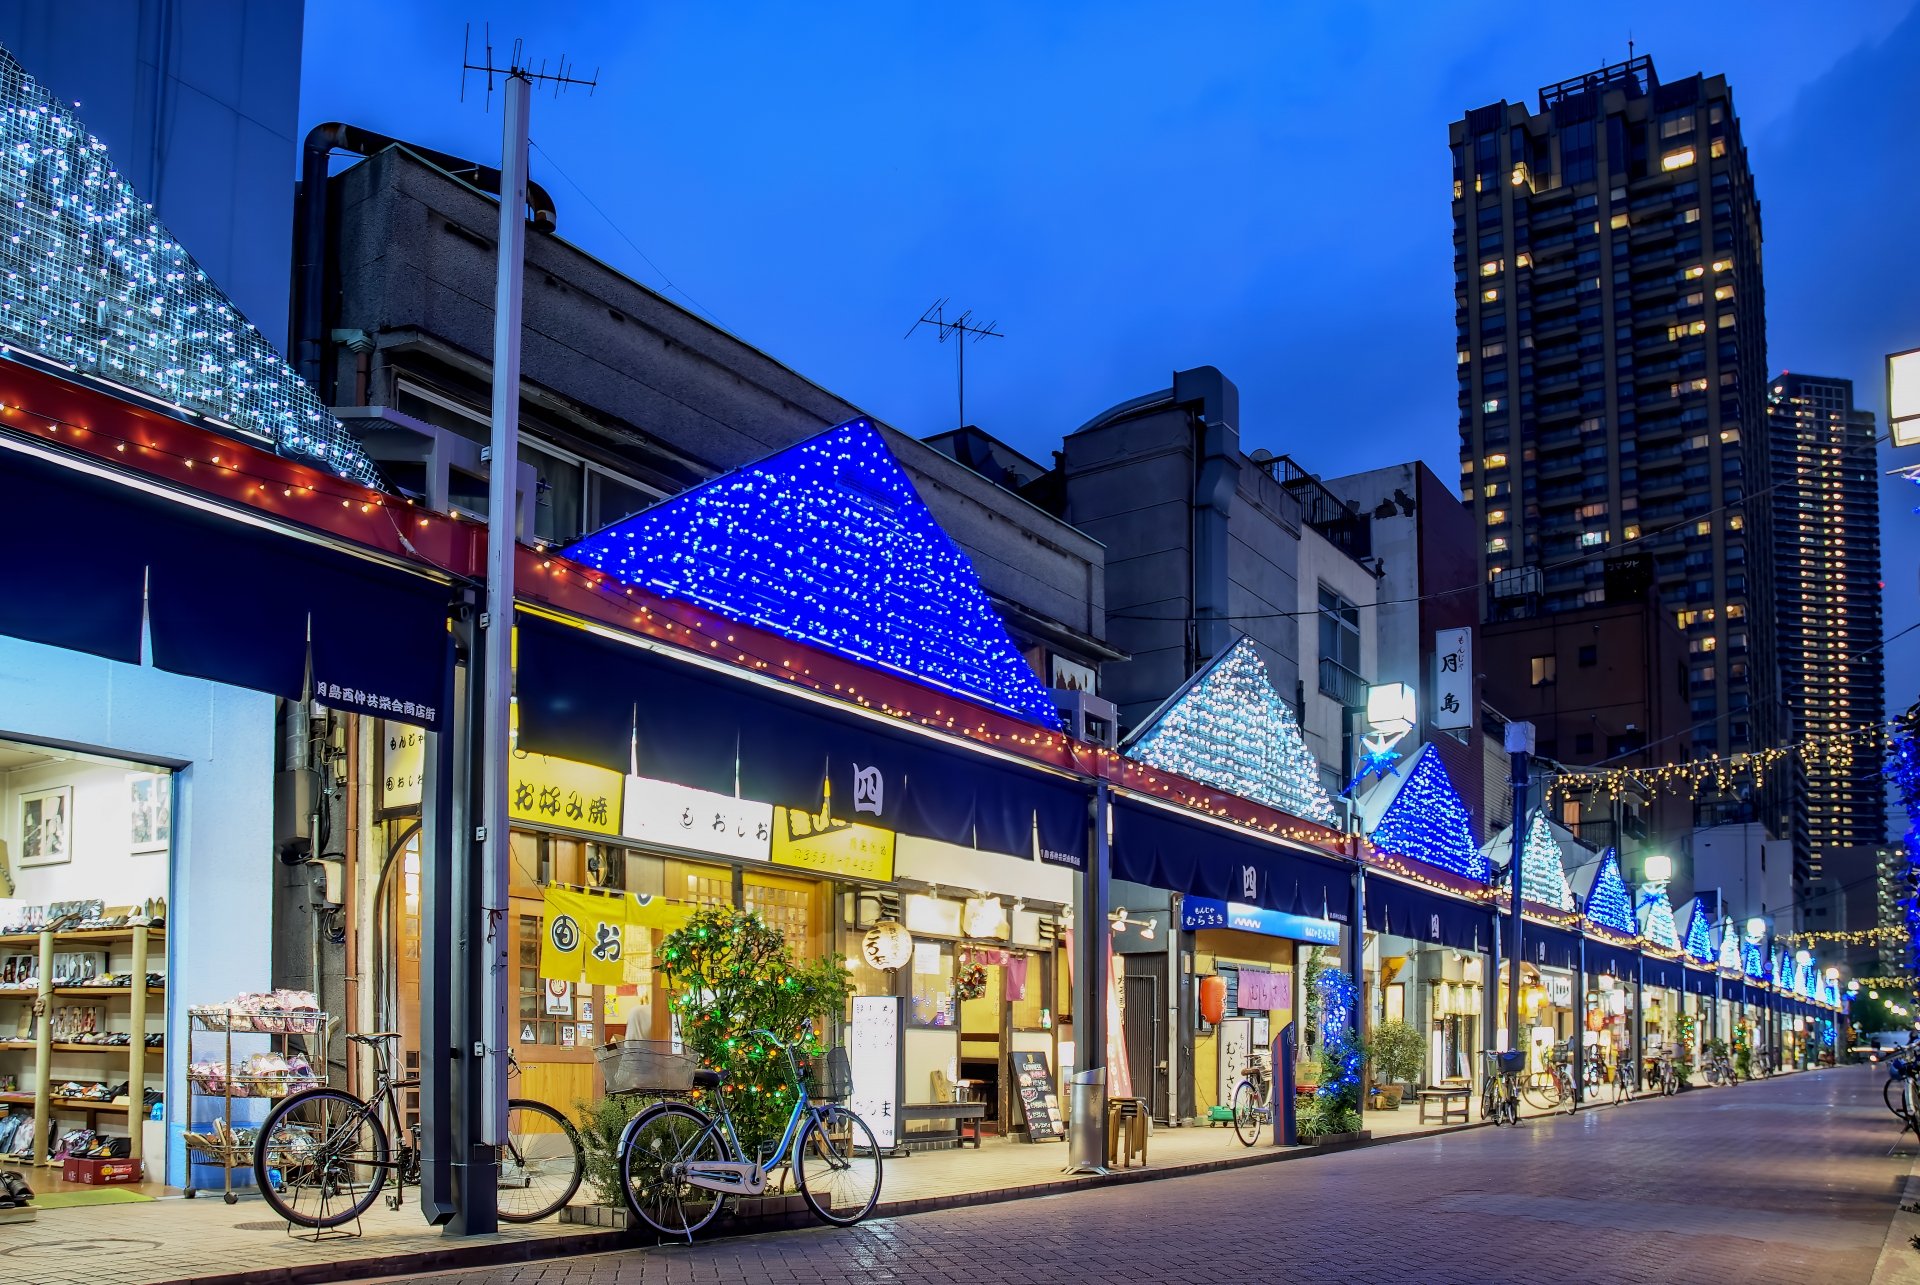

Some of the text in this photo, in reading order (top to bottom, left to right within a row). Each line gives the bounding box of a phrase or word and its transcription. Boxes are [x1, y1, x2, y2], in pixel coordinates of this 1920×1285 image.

[1457, 635, 1465, 670] もんじゃ
[317, 681, 436, 721] 月島西仲共栄会商店街
[1440, 653, 1460, 714] 月島
[514, 780, 608, 826] お好み焼
[853, 763, 884, 817] 四
[1243, 865, 1257, 899] 四
[1186, 914, 1224, 926] むらさき
[1251, 983, 1289, 1001] むらさき
